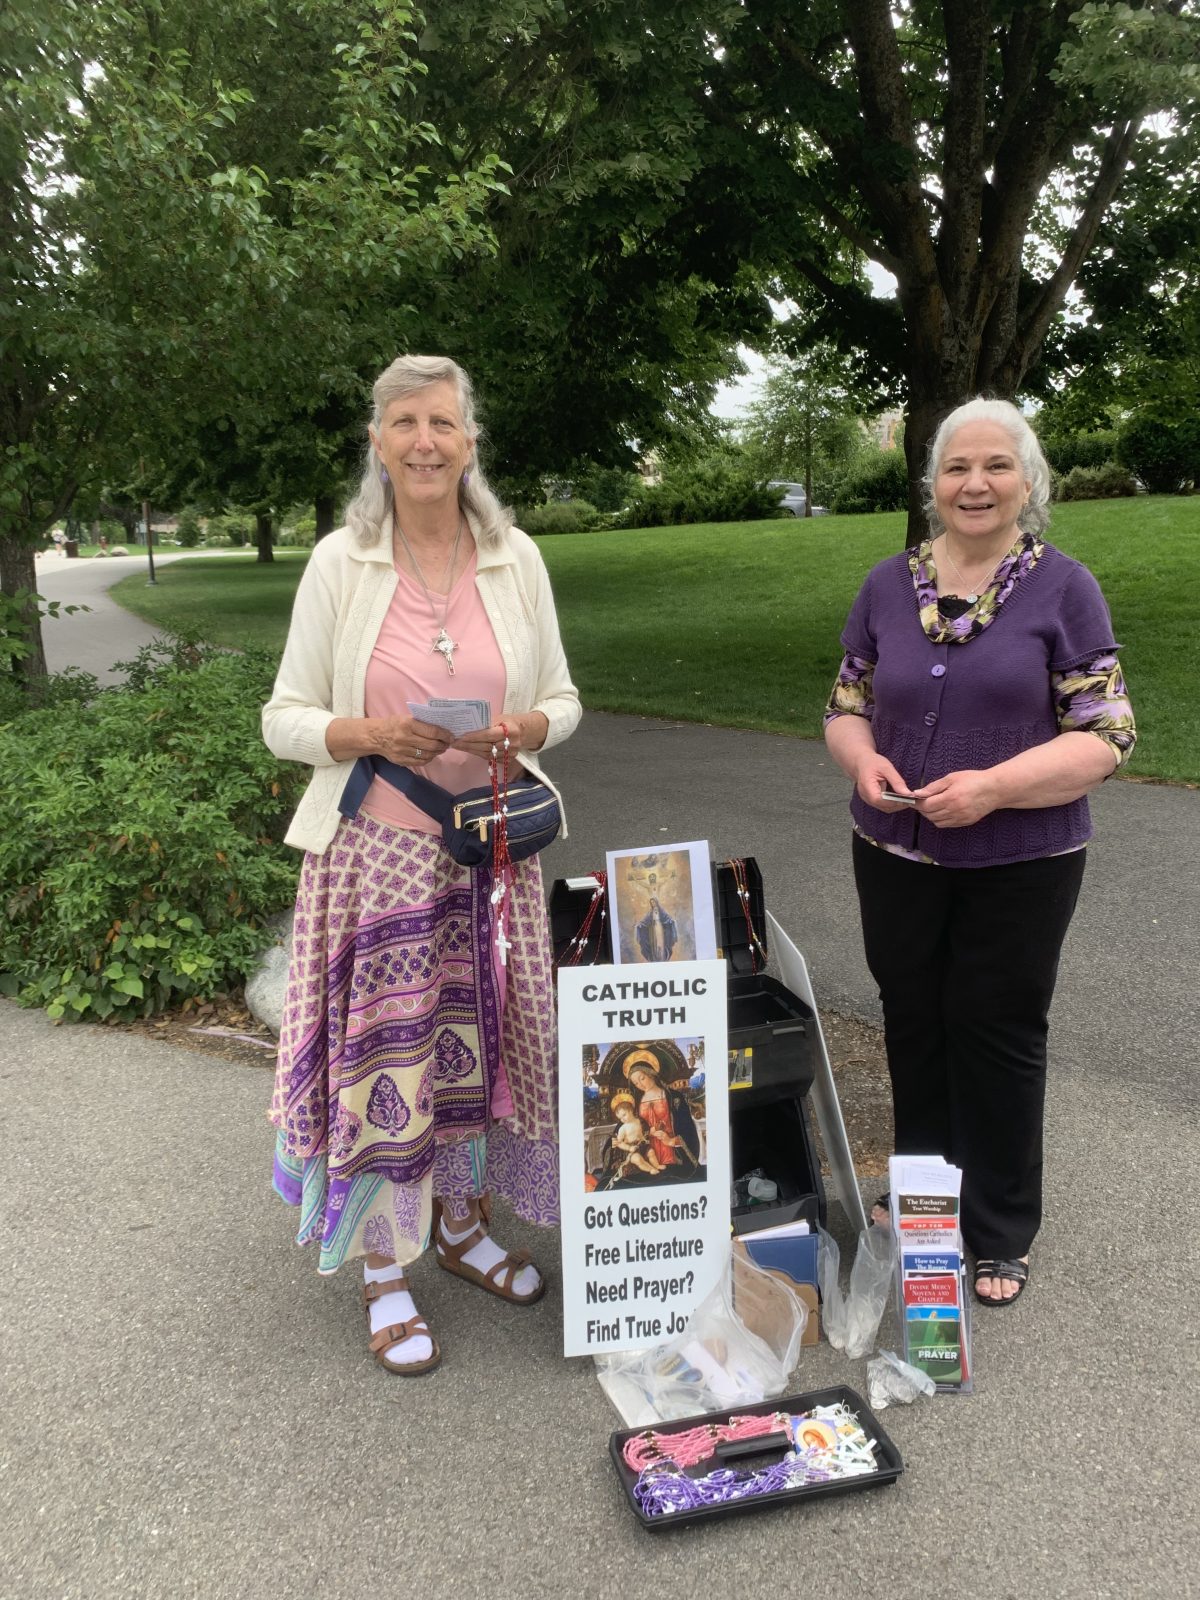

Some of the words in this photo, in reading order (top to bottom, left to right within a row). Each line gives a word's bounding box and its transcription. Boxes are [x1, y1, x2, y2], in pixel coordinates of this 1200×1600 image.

[582, 978, 707, 1002] CATHOLIC
[602, 1006, 686, 1028] TRUTH
[584, 1205, 613, 1229] Got
[618, 1195, 708, 1227] Questions?
[585, 1243, 620, 1267] Free
[626, 1236, 704, 1263] Literature
[936, 1258, 949, 1266] Pray
[586, 1277, 628, 1304] Need
[633, 1270, 694, 1303] Prayer?
[587, 1317, 620, 1344] Find
[625, 1315, 661, 1339] True
[918, 1350, 958, 1359] PRAYER
